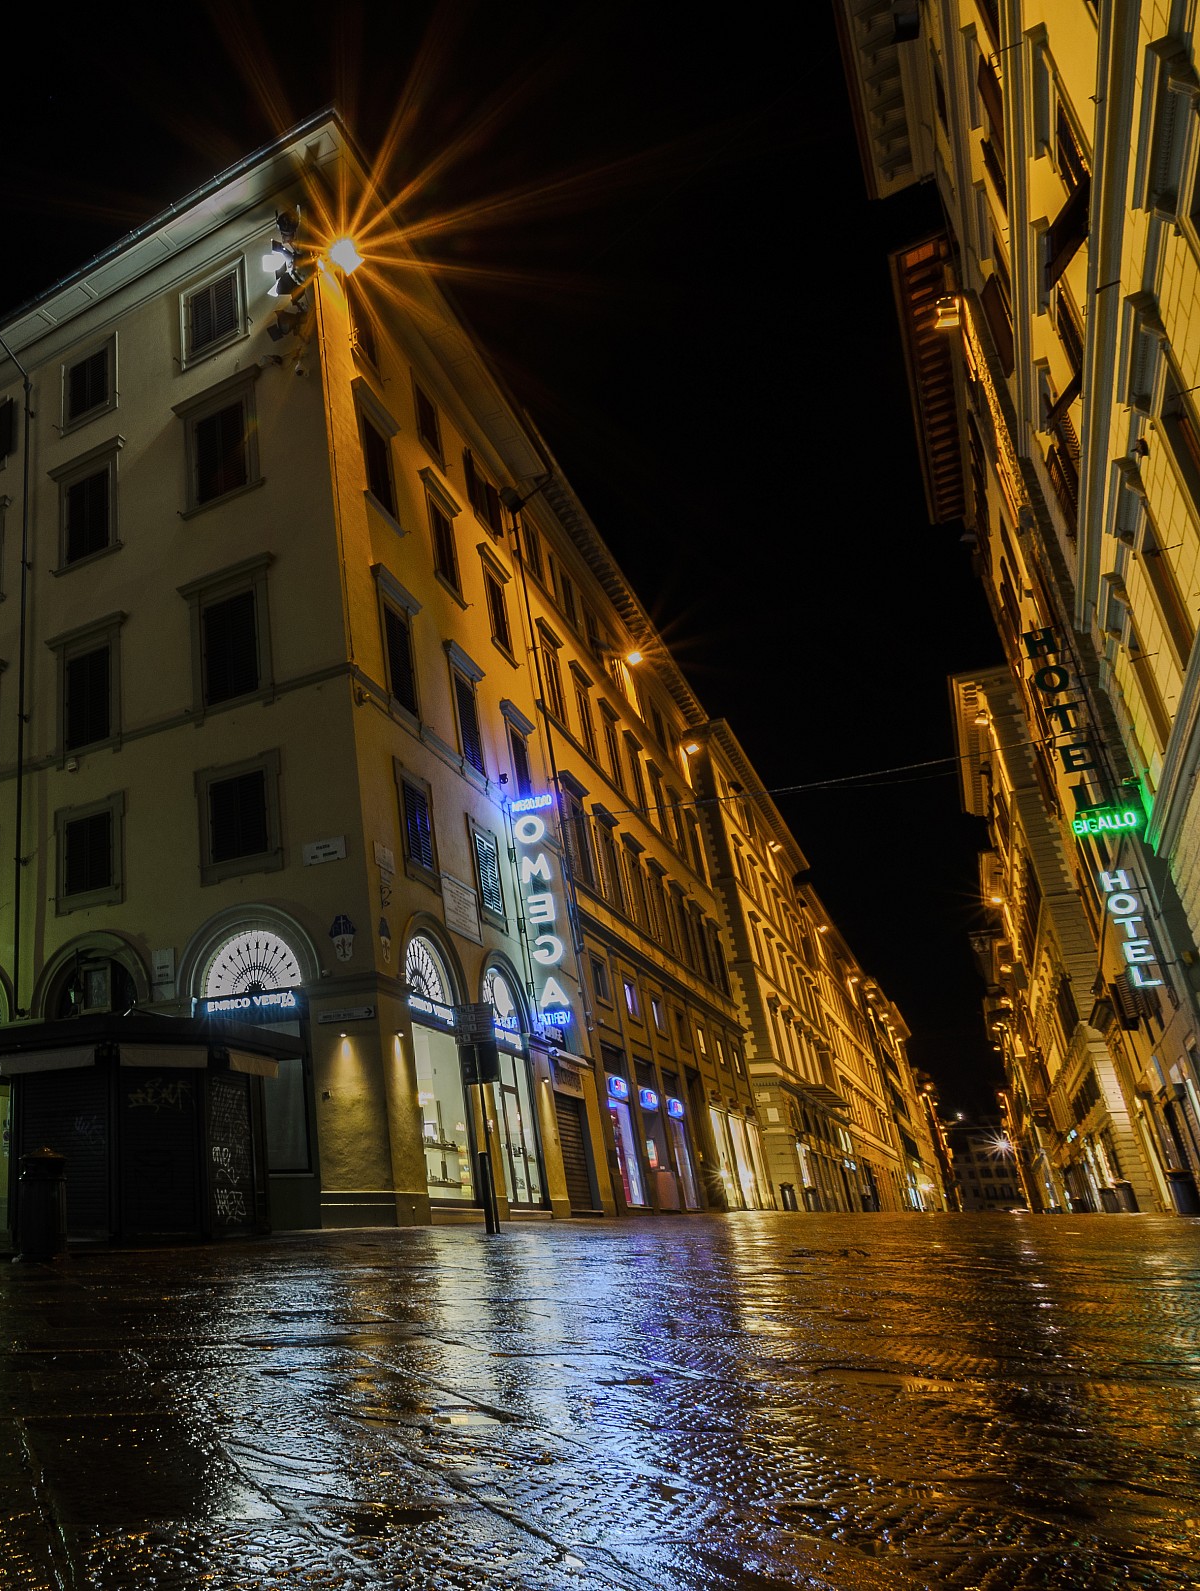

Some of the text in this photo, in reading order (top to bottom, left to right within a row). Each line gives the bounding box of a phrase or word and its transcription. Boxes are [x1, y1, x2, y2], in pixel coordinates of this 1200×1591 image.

[1023, 628, 1111, 812] HOTEL
[1073, 811, 1137, 833] BIGALLO
[1100, 868, 1162, 987] HOTEL
[206, 997, 251, 1012] ENRICO
